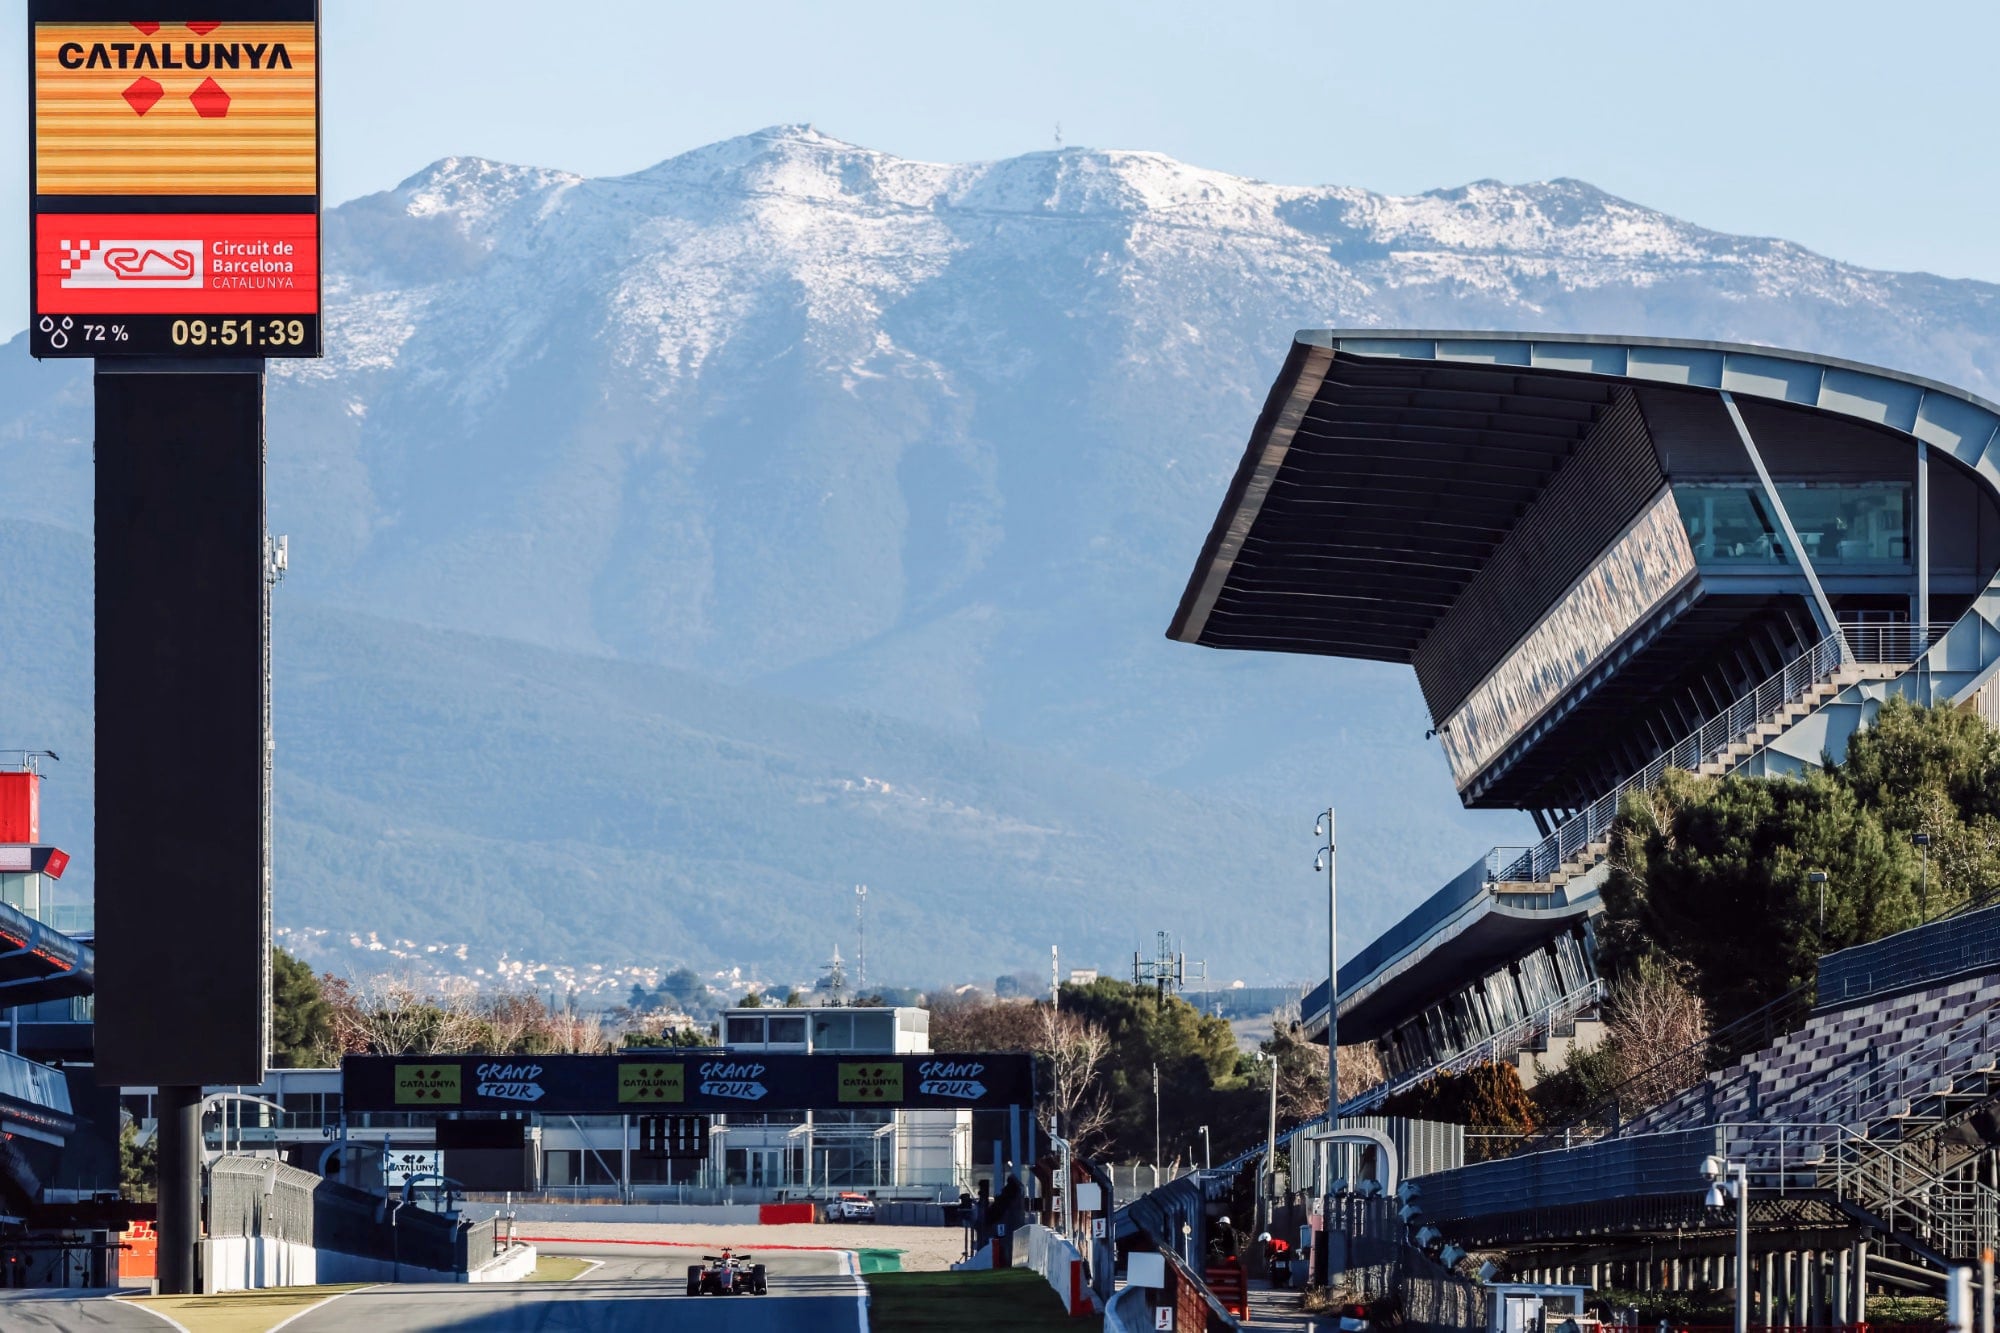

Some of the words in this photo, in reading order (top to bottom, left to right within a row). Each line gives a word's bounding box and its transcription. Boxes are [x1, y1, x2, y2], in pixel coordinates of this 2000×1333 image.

[58, 43, 293, 69] CATALUNYA
[212, 240, 270, 255] Circuit
[273, 240, 294, 255] de
[213, 259, 294, 273] Barcelona
[212, 277, 294, 288] CATALUNYA
[83, 325, 106, 341] 72
[112, 325, 129, 341] %
[172, 319, 304, 345] 09:51:39
[476, 1064, 543, 1081] GRAND
[700, 1062, 765, 1079] GRAND
[919, 1061, 984, 1079] GRAND
[400, 1080, 456, 1088] CATALUNYA
[623, 1079, 679, 1087] CATALUNYA
[706, 1082, 757, 1097] TOUR
[843, 1078, 898, 1086] CATALUNYA
[926, 1080, 976, 1096] TOUR
[484, 1084, 533, 1099] TOUR
